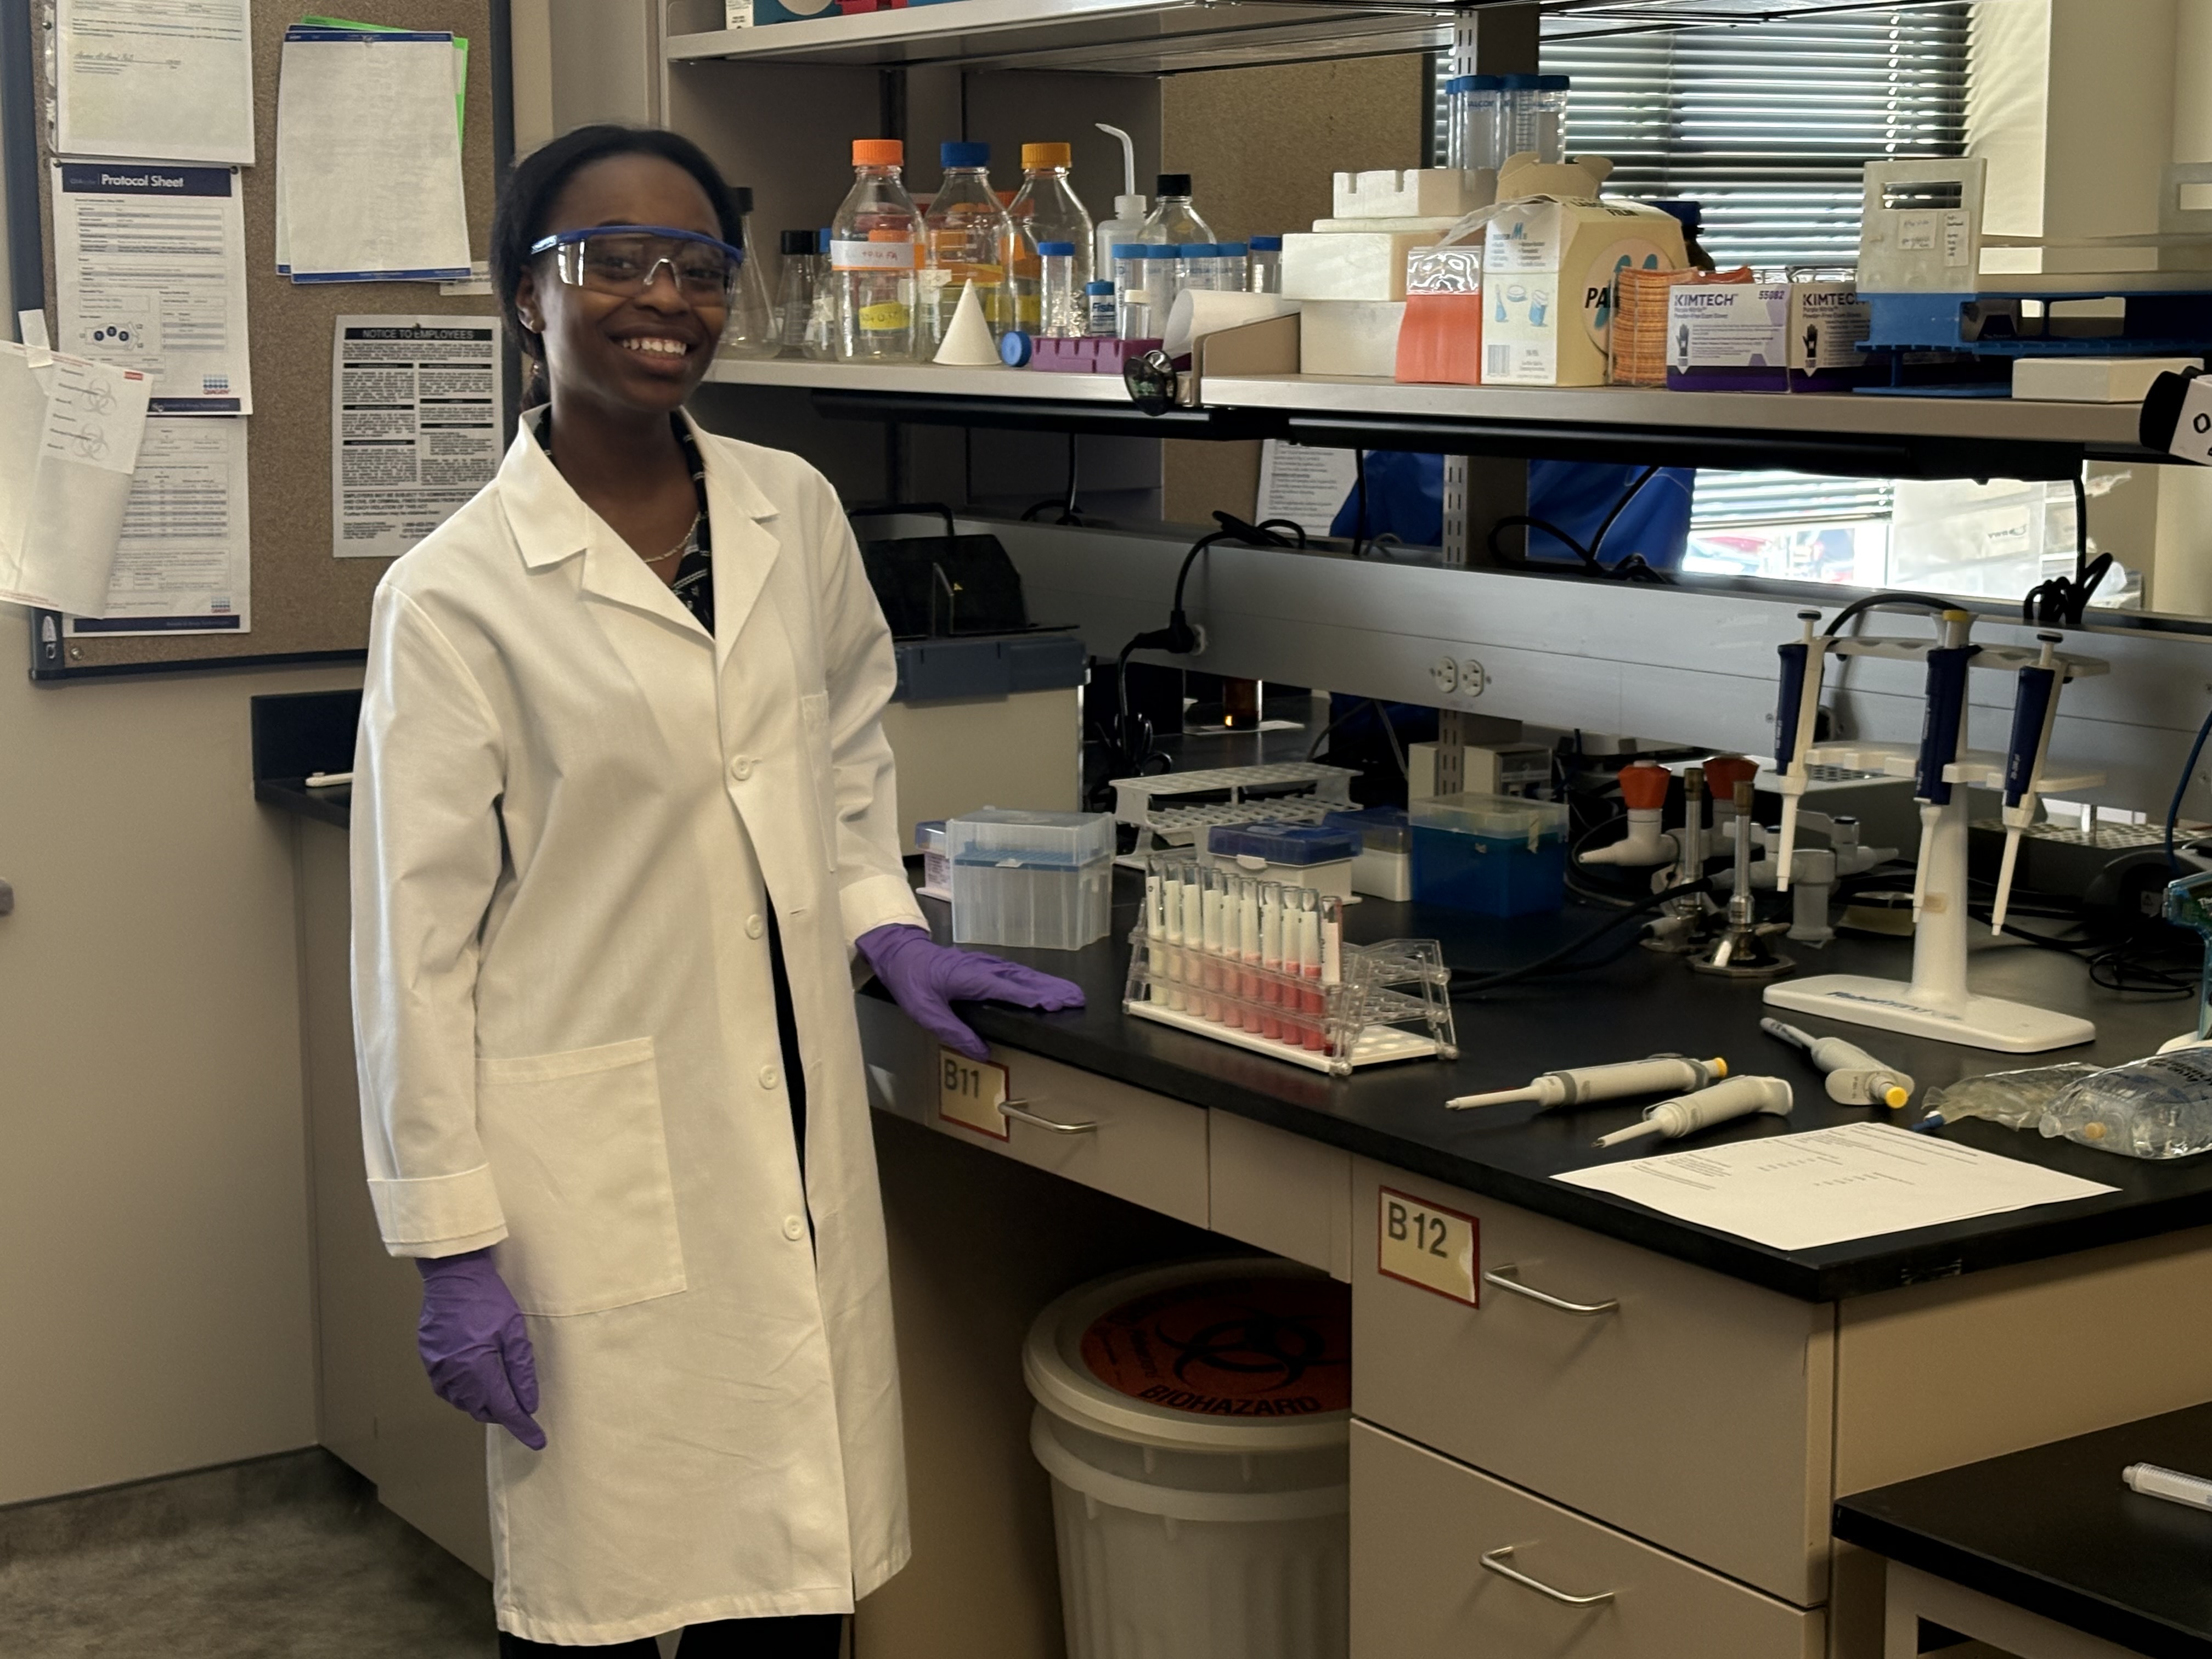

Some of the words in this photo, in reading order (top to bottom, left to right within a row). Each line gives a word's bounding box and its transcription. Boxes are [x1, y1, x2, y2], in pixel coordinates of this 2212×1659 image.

[101, 174, 148, 186] Protocol
[151, 175, 184, 187] Sheet
[1606, 208, 1639, 217] FILM
[1584, 287, 1620, 308] PA
[1674, 294, 1734, 306] KIMTECH
[1803, 292, 1865, 306] KIMTEC
[363, 329, 397, 338] NOTICE
[399, 330, 411, 338] TO
[414, 330, 474, 339] EMPLOYEES
[944, 1058, 979, 1099] B11
[1388, 1200, 1448, 1259] B12
[1138, 1383, 1323, 1415] BIOHAZARD
